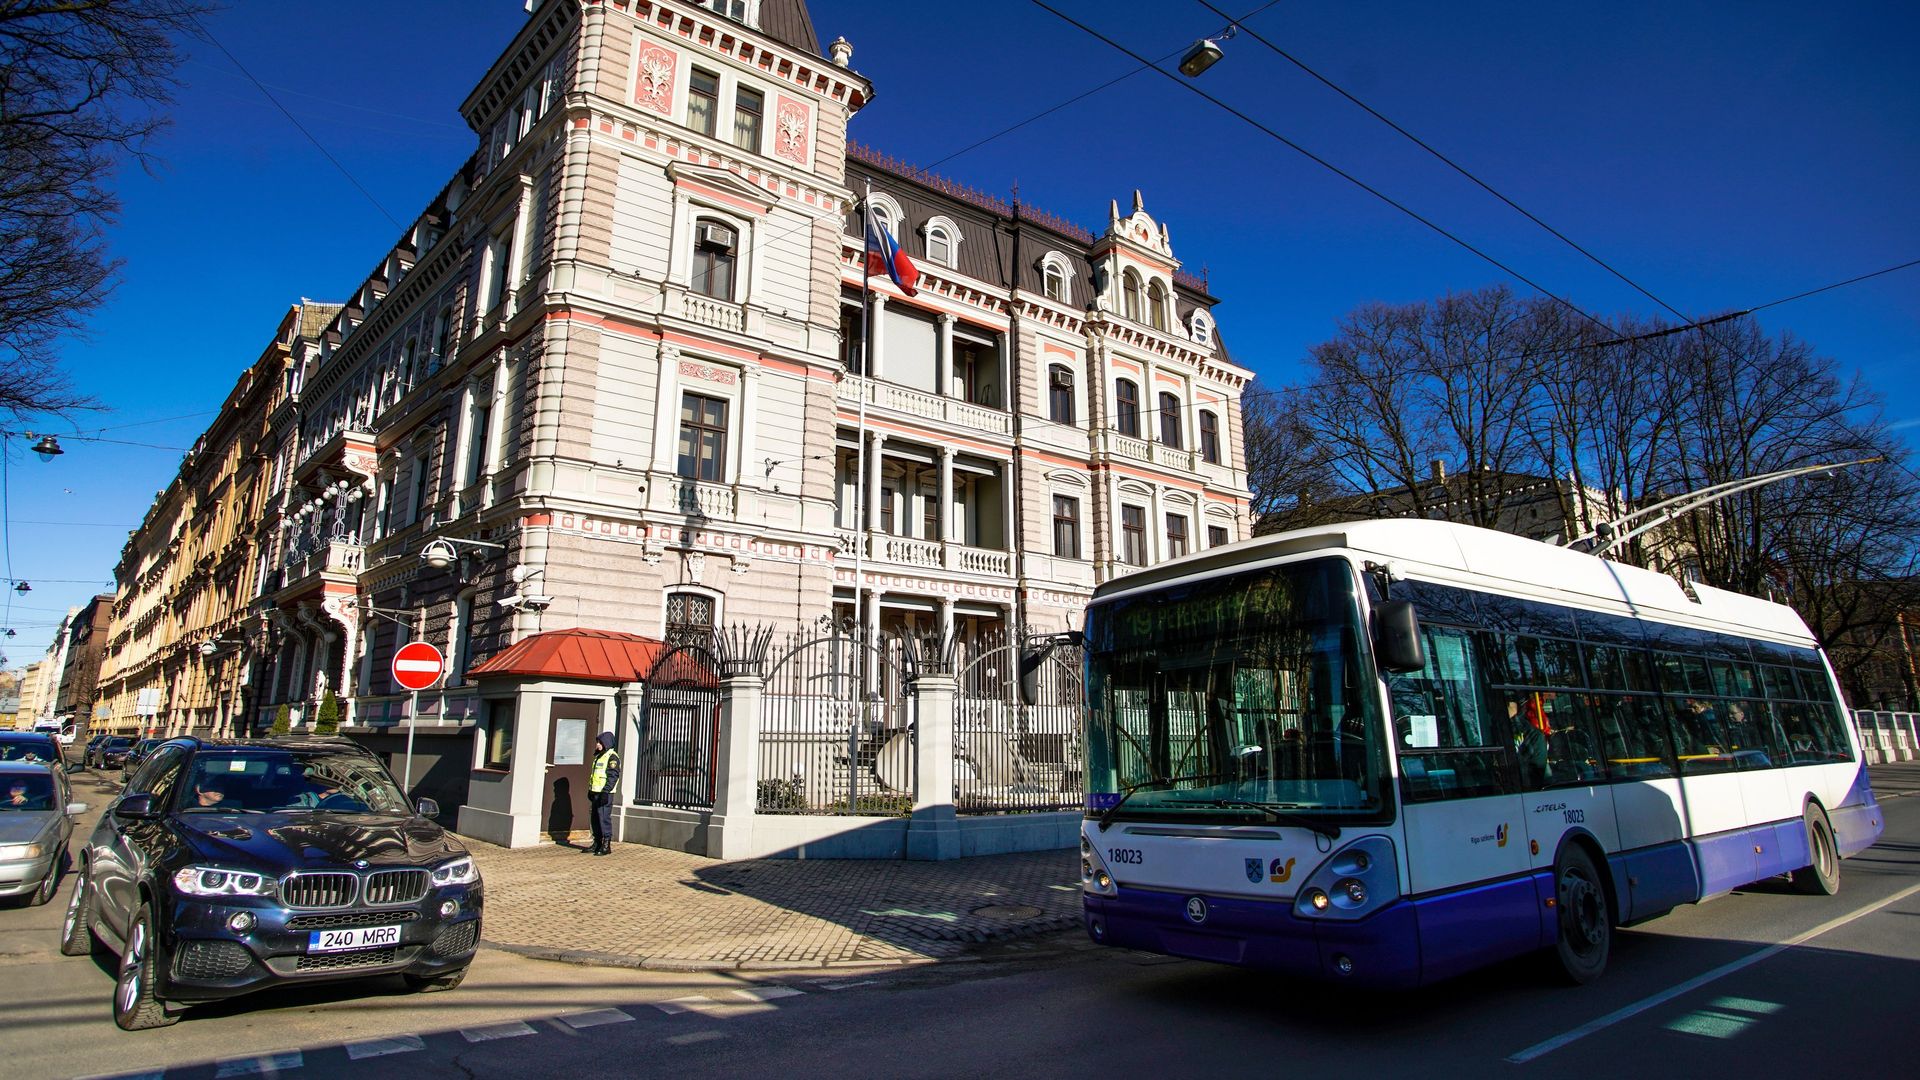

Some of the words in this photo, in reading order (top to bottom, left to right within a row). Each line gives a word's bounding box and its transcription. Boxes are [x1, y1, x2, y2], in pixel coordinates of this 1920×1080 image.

[1126, 608, 1152, 636] 19
[1536, 802, 1566, 813] CITELIS
[1563, 809, 1584, 824] 18023
[1108, 848, 1143, 864] 18023
[324, 931, 353, 947] 240
[362, 927, 397, 945] MRR
